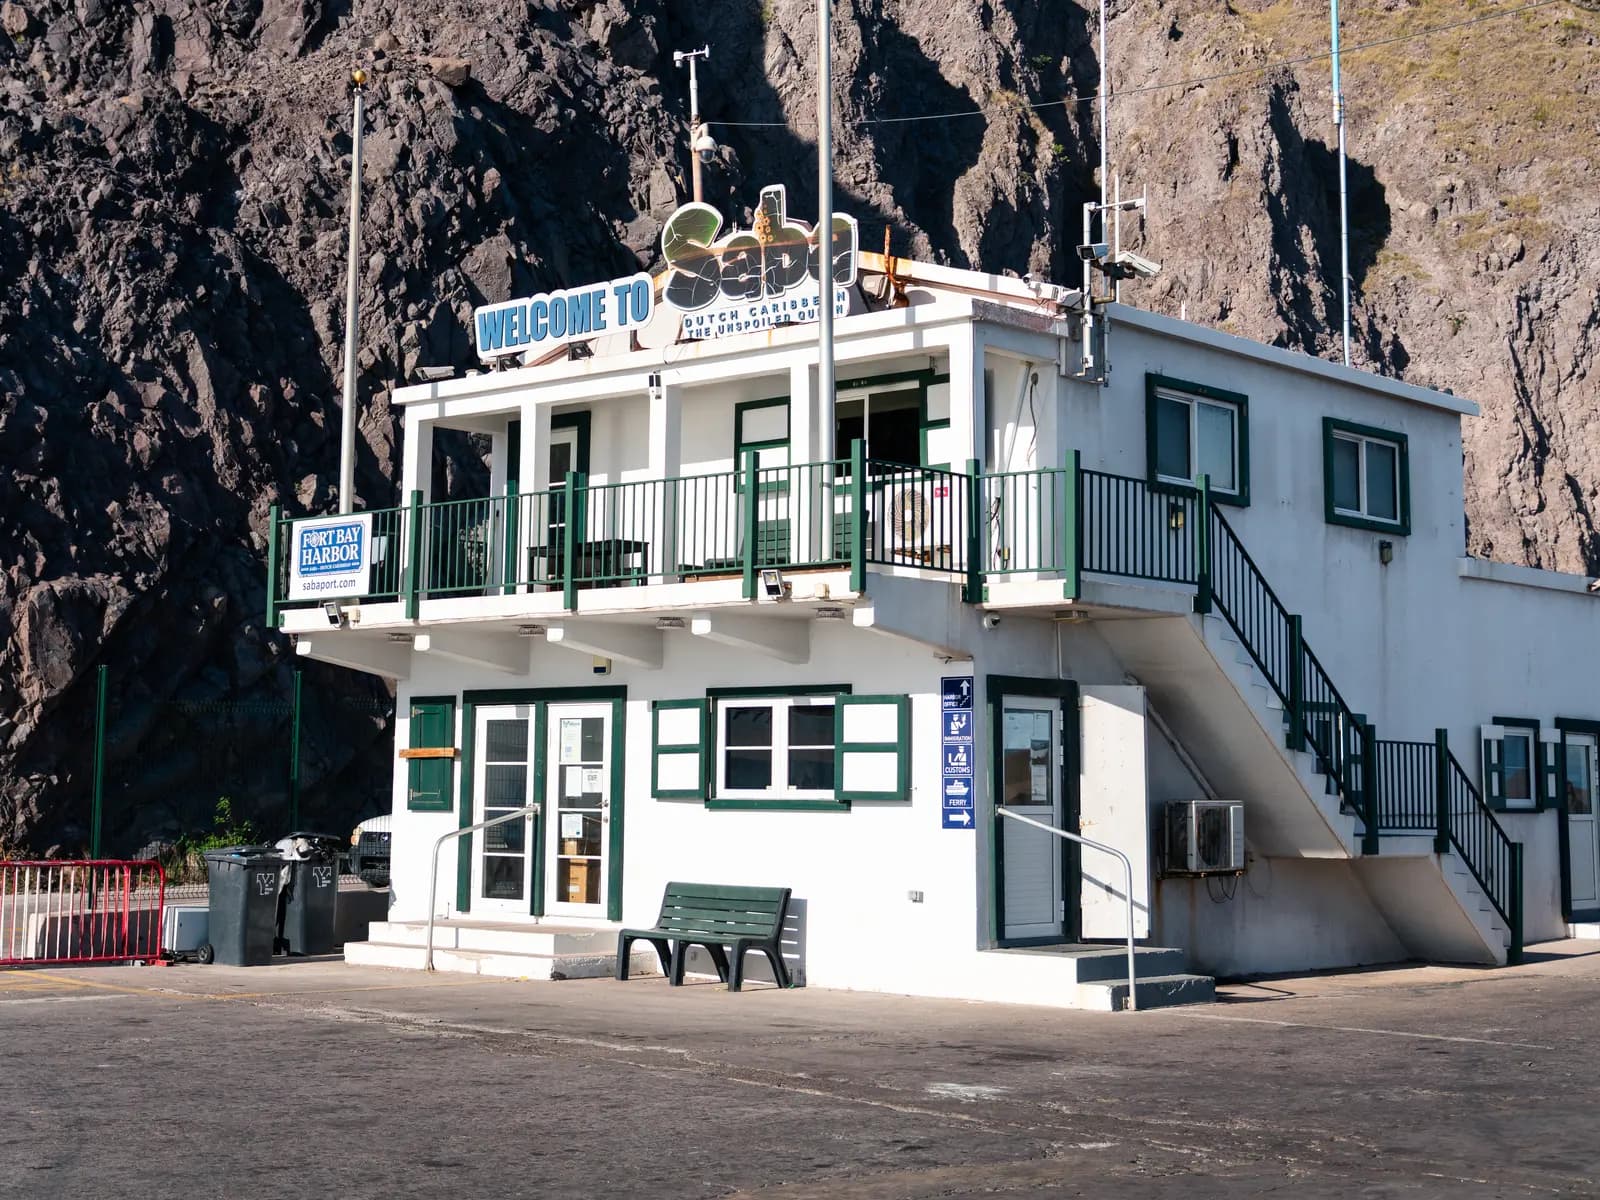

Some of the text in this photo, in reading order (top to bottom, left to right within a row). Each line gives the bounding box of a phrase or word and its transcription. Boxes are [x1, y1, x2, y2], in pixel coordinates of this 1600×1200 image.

[478, 279, 650, 352] WELCOME TO
[684, 289, 846, 329] DUTCH CARIBBEN
[687, 304, 844, 338] THE UNSPOILED QUN
[302, 526, 361, 548] FORT BAY
[302, 543, 359, 566] HARBOR
[302, 579, 356, 592] sabaport.com
[945, 766, 971, 774] CUSTOMS
